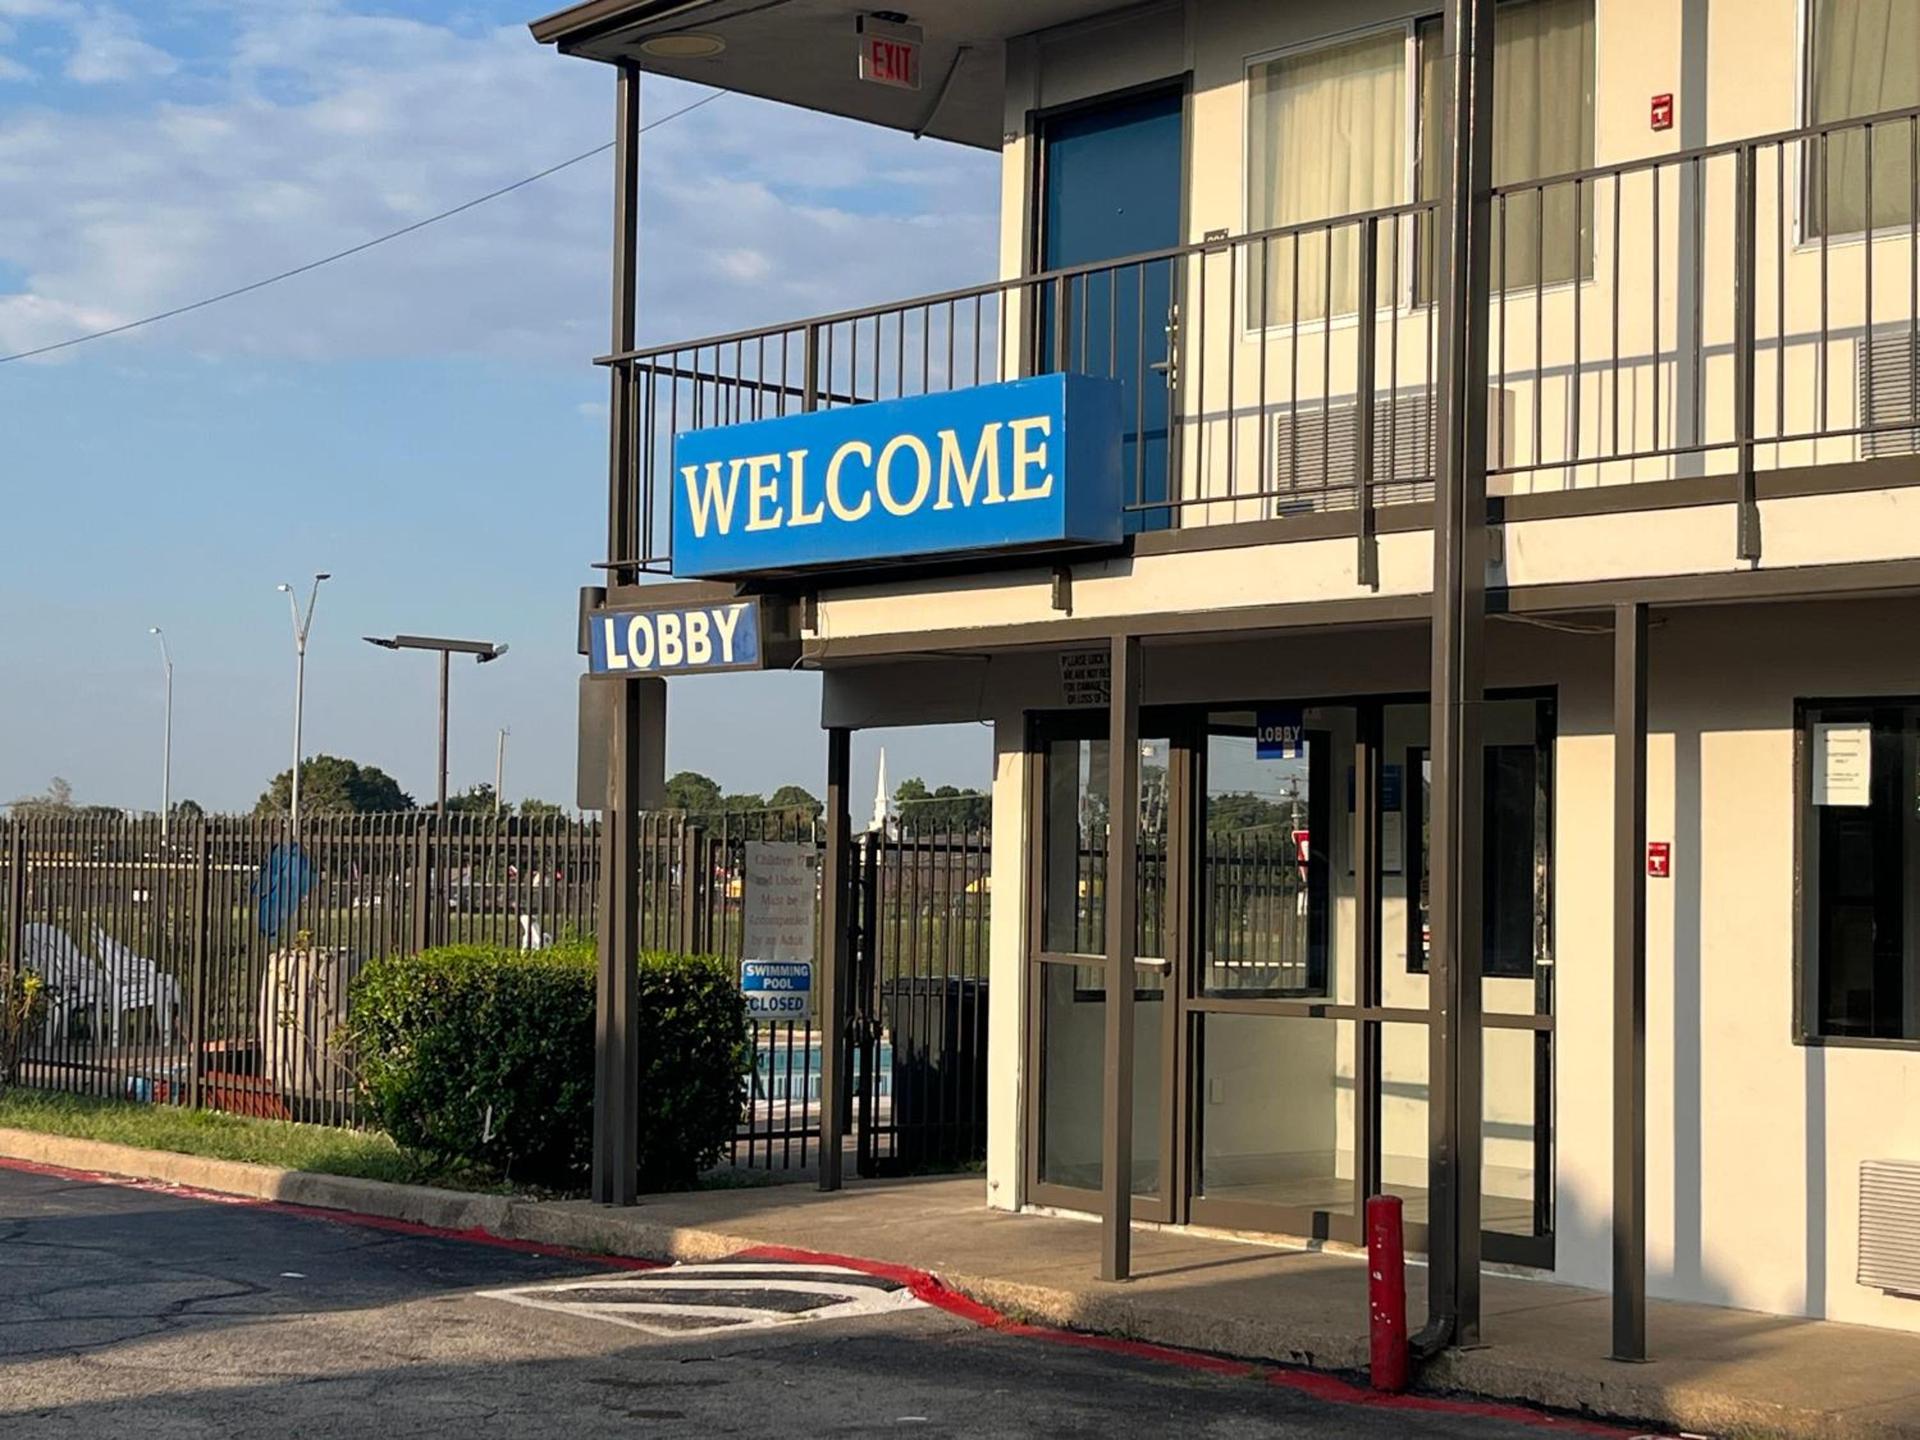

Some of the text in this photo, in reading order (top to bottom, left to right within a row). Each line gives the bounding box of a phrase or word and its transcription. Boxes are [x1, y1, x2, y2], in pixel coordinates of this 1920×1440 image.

[872, 40, 912, 83] EXIT
[680, 416, 1054, 539] WELCOME
[604, 608, 741, 670] LOBBY
[1257, 725, 1301, 743] LOBBY
[755, 854, 794, 866] Children
[746, 964, 809, 977] SWIMMING
[763, 977, 795, 990] POOL
[749, 996, 804, 1012] CLOSED
